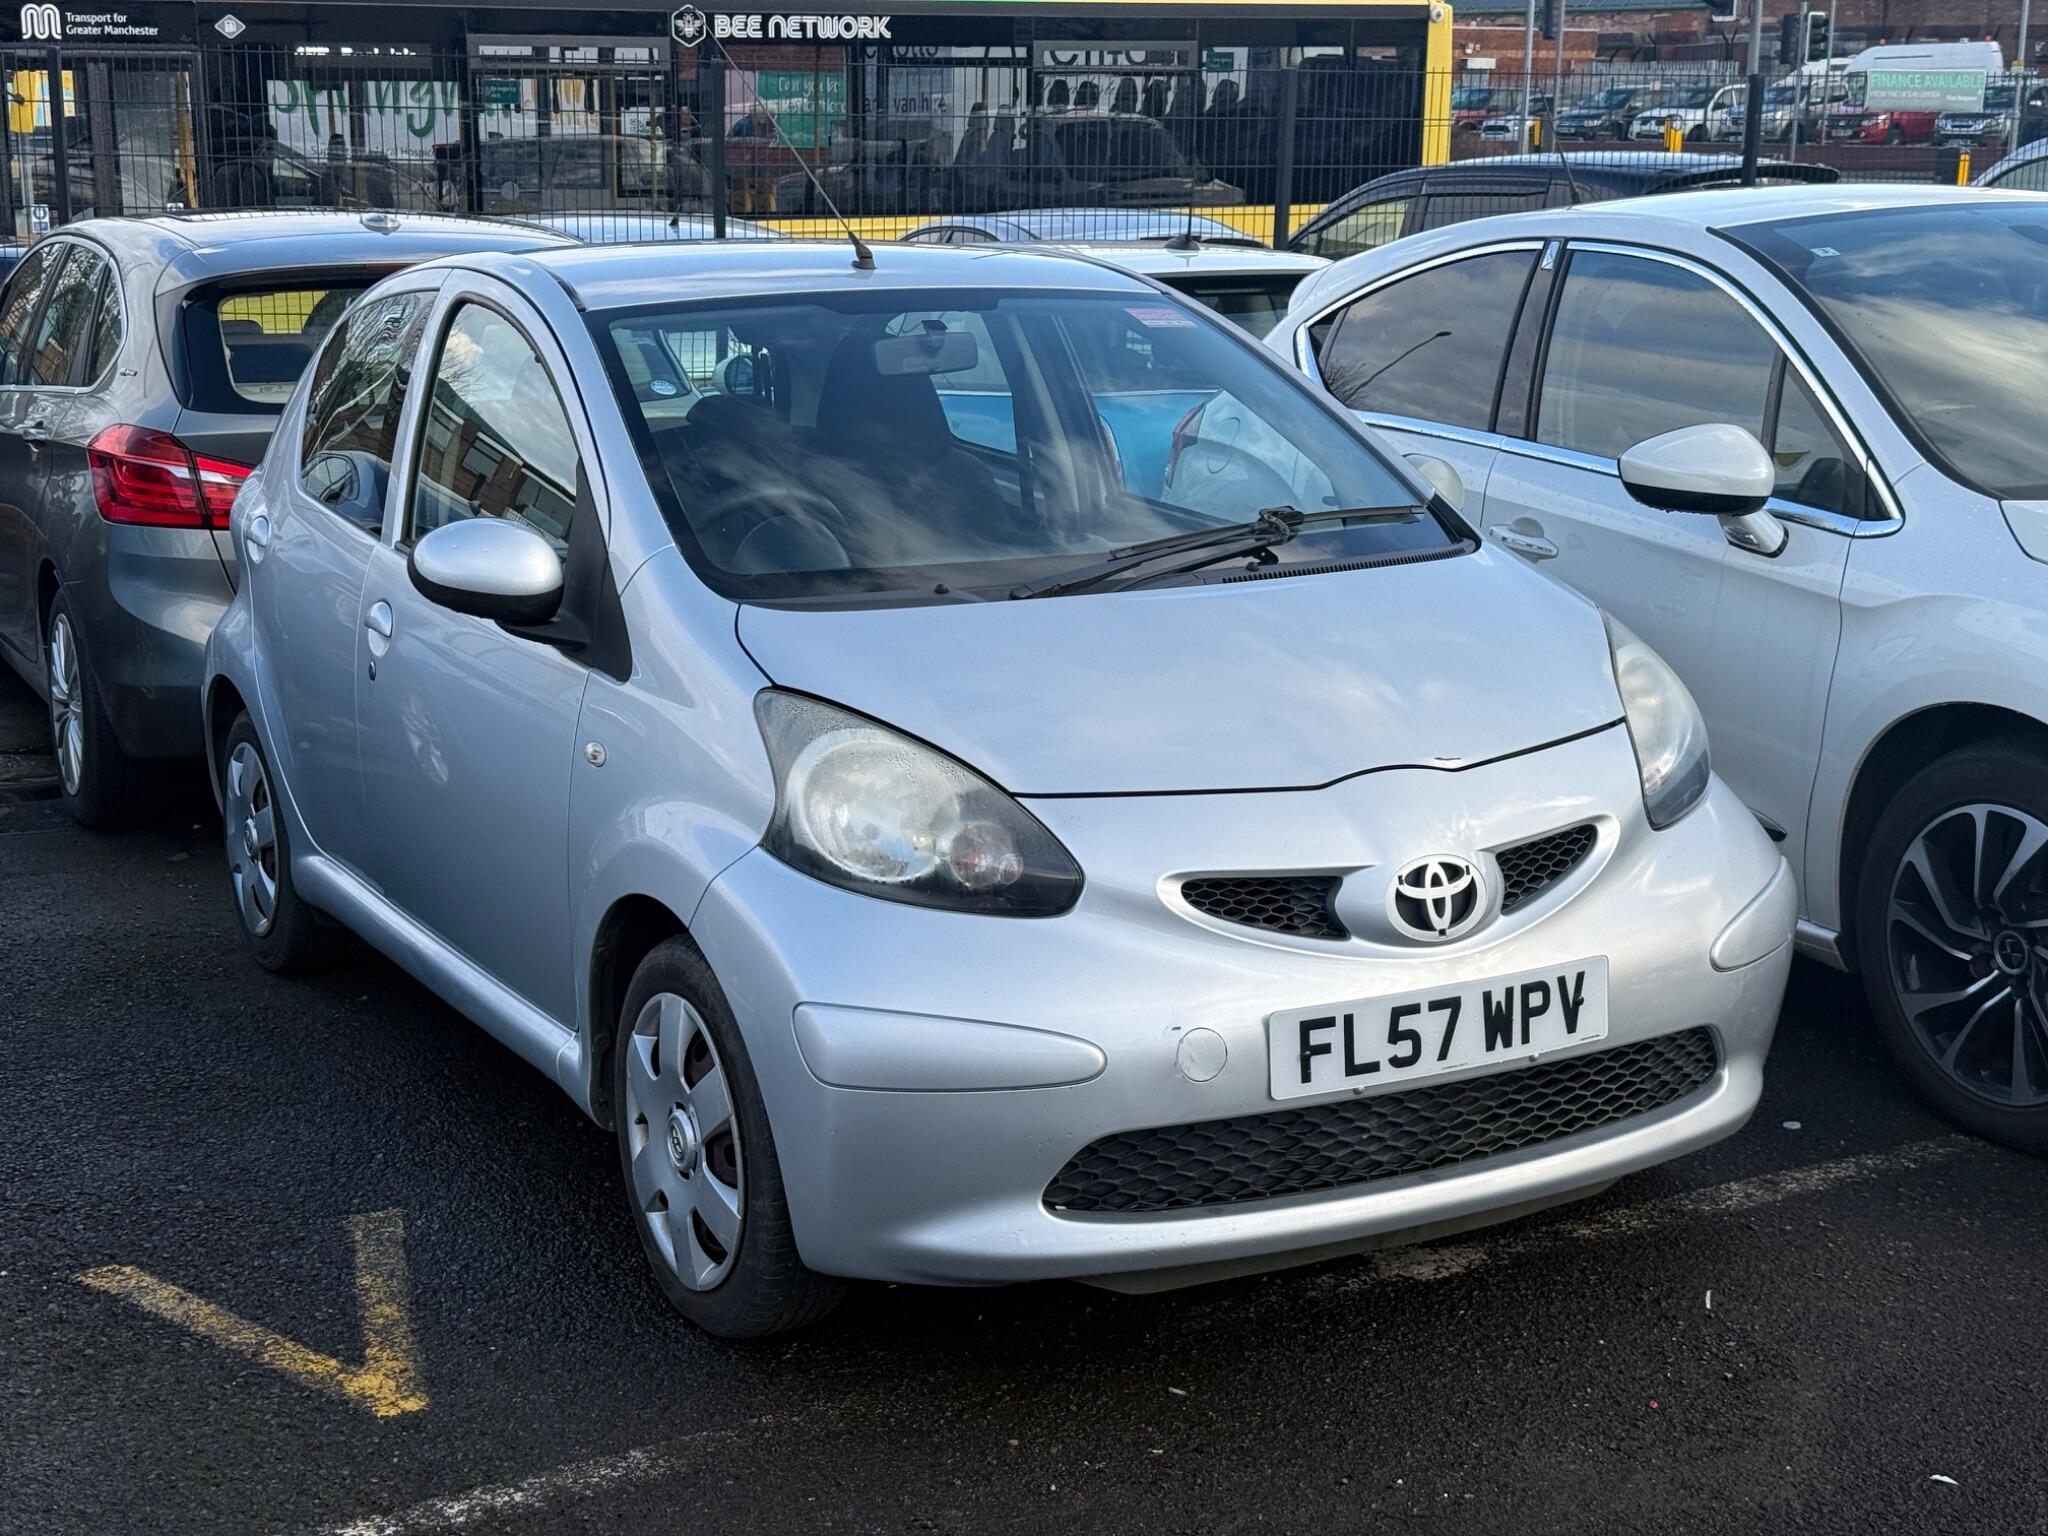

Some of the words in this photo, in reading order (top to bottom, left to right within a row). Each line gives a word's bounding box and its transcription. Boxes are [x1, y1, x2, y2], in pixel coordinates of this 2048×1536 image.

[65, 12, 112, 25] Transport
[113, 12, 127, 23] for
[66, 25, 102, 35] Greater
[104, 25, 159, 36] Manchester
[714, 14, 763, 39] BEE
[768, 15, 892, 40] NETWORK
[1870, 74, 1921, 88] FINANCE
[1924, 74, 1984, 88] AVAILABLE
[1299, 996, 1462, 1084] FL57
[1482, 971, 1586, 1053] WPV
